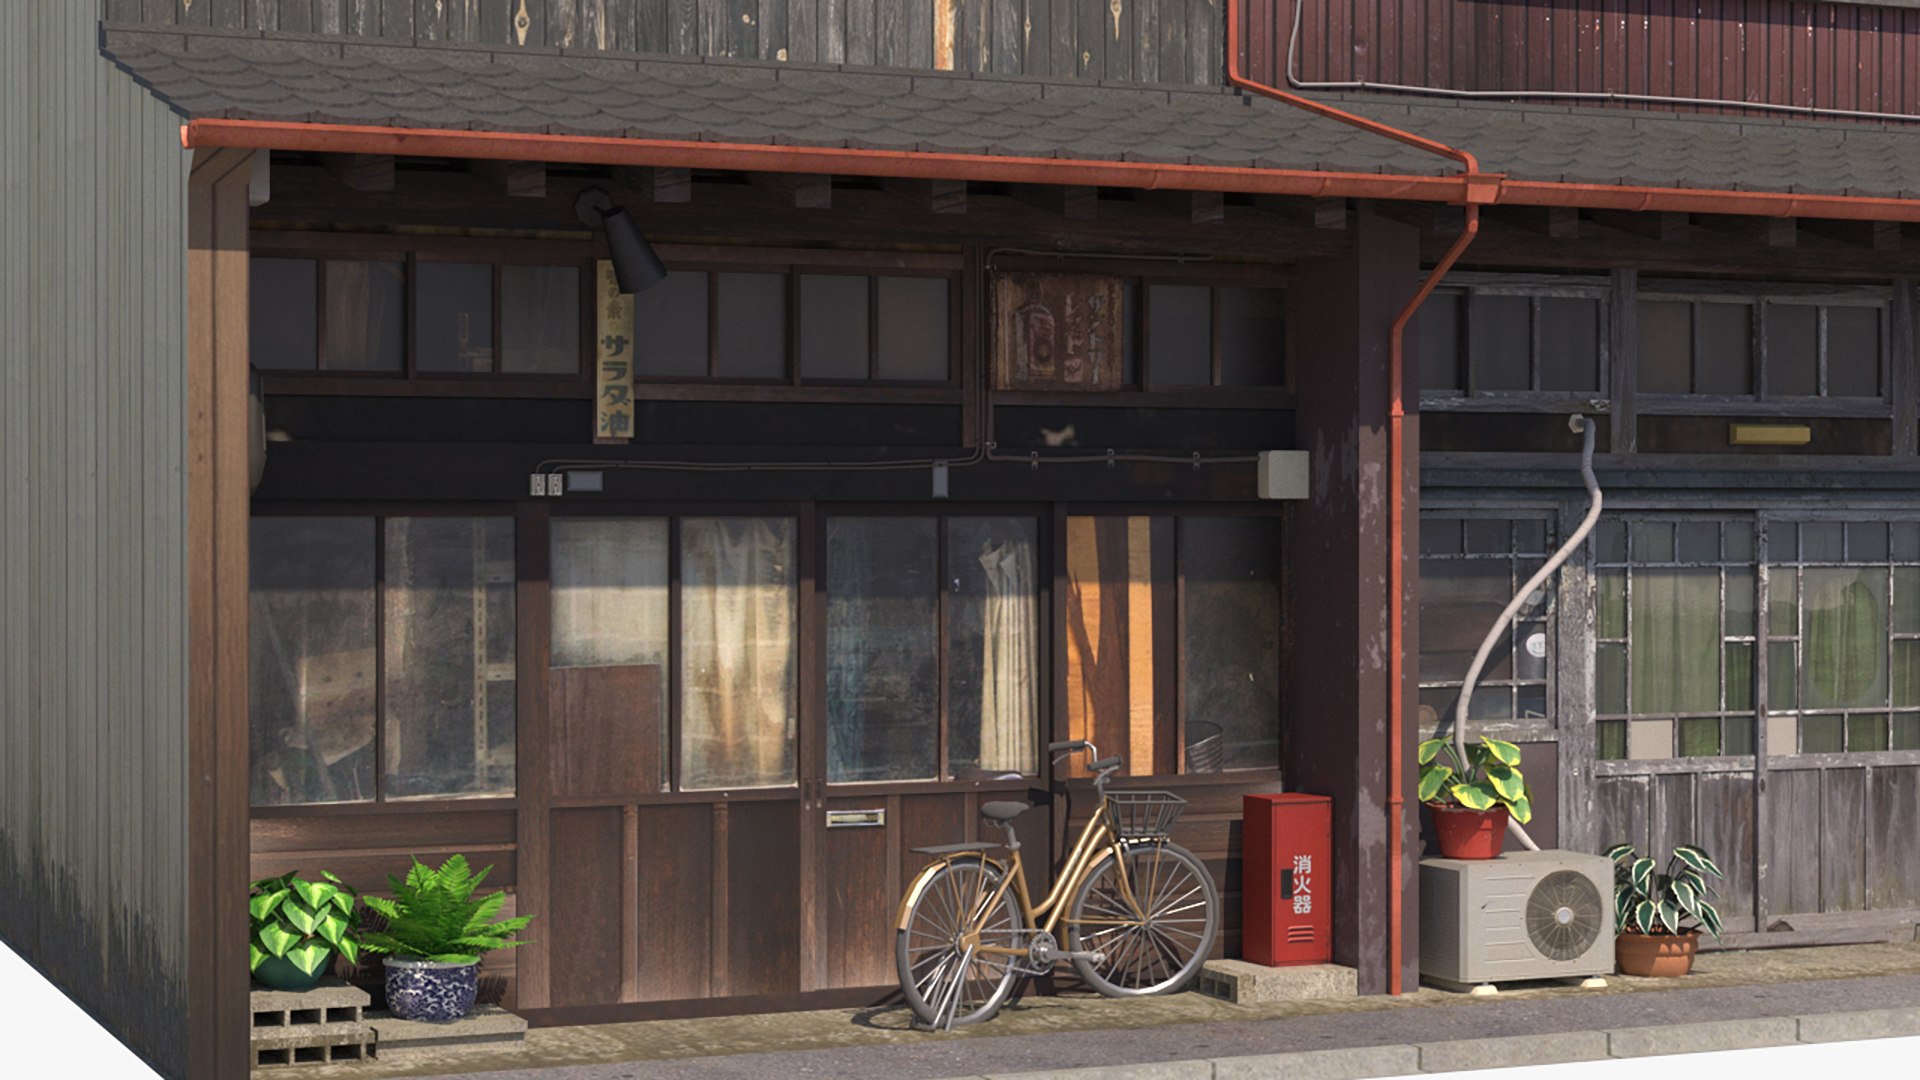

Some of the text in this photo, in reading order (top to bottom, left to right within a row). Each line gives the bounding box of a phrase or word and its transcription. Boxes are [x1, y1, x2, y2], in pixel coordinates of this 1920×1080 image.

[600, 334, 631, 432] サラダ油
[1293, 855, 1312, 914] 消火器
